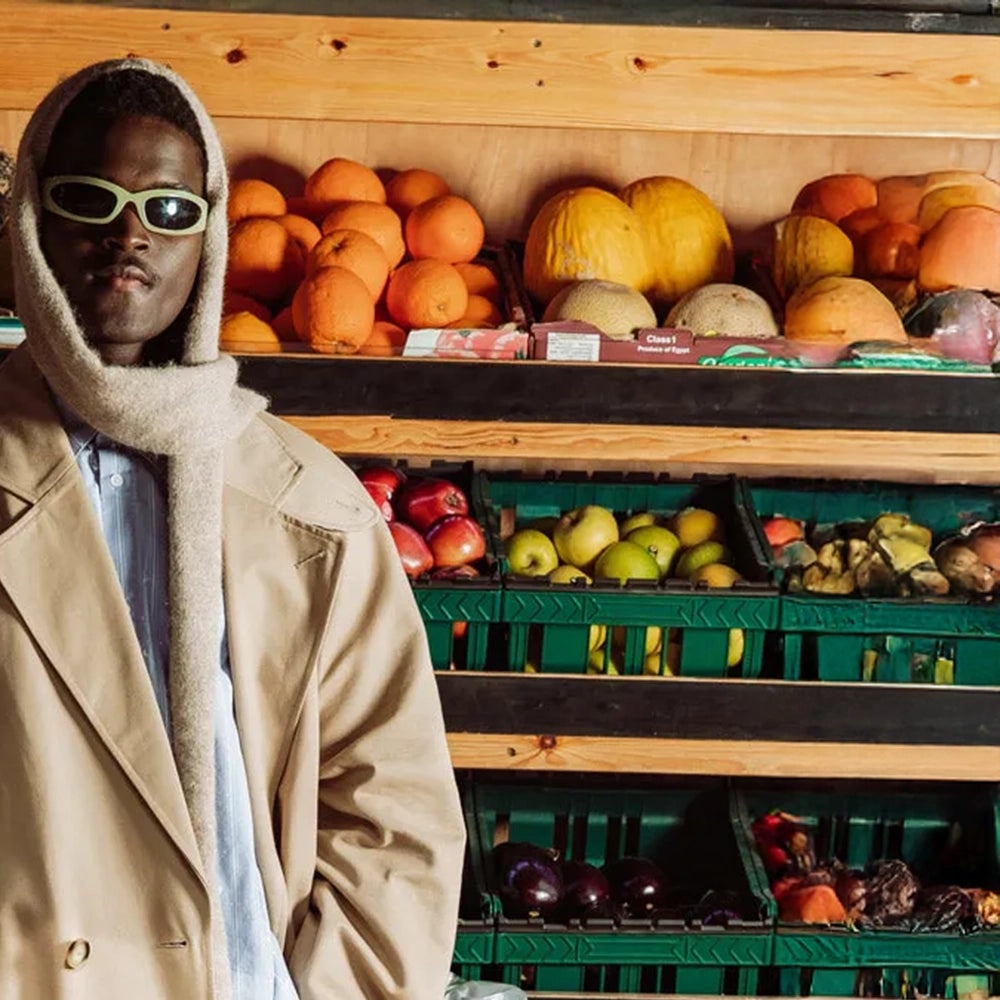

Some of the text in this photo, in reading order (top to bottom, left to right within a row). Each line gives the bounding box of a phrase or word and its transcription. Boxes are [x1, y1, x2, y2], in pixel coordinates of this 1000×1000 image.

[646, 334, 671, 344] Class
[637, 345, 663, 353] Produce
[672, 346, 690, 355] Egypt
